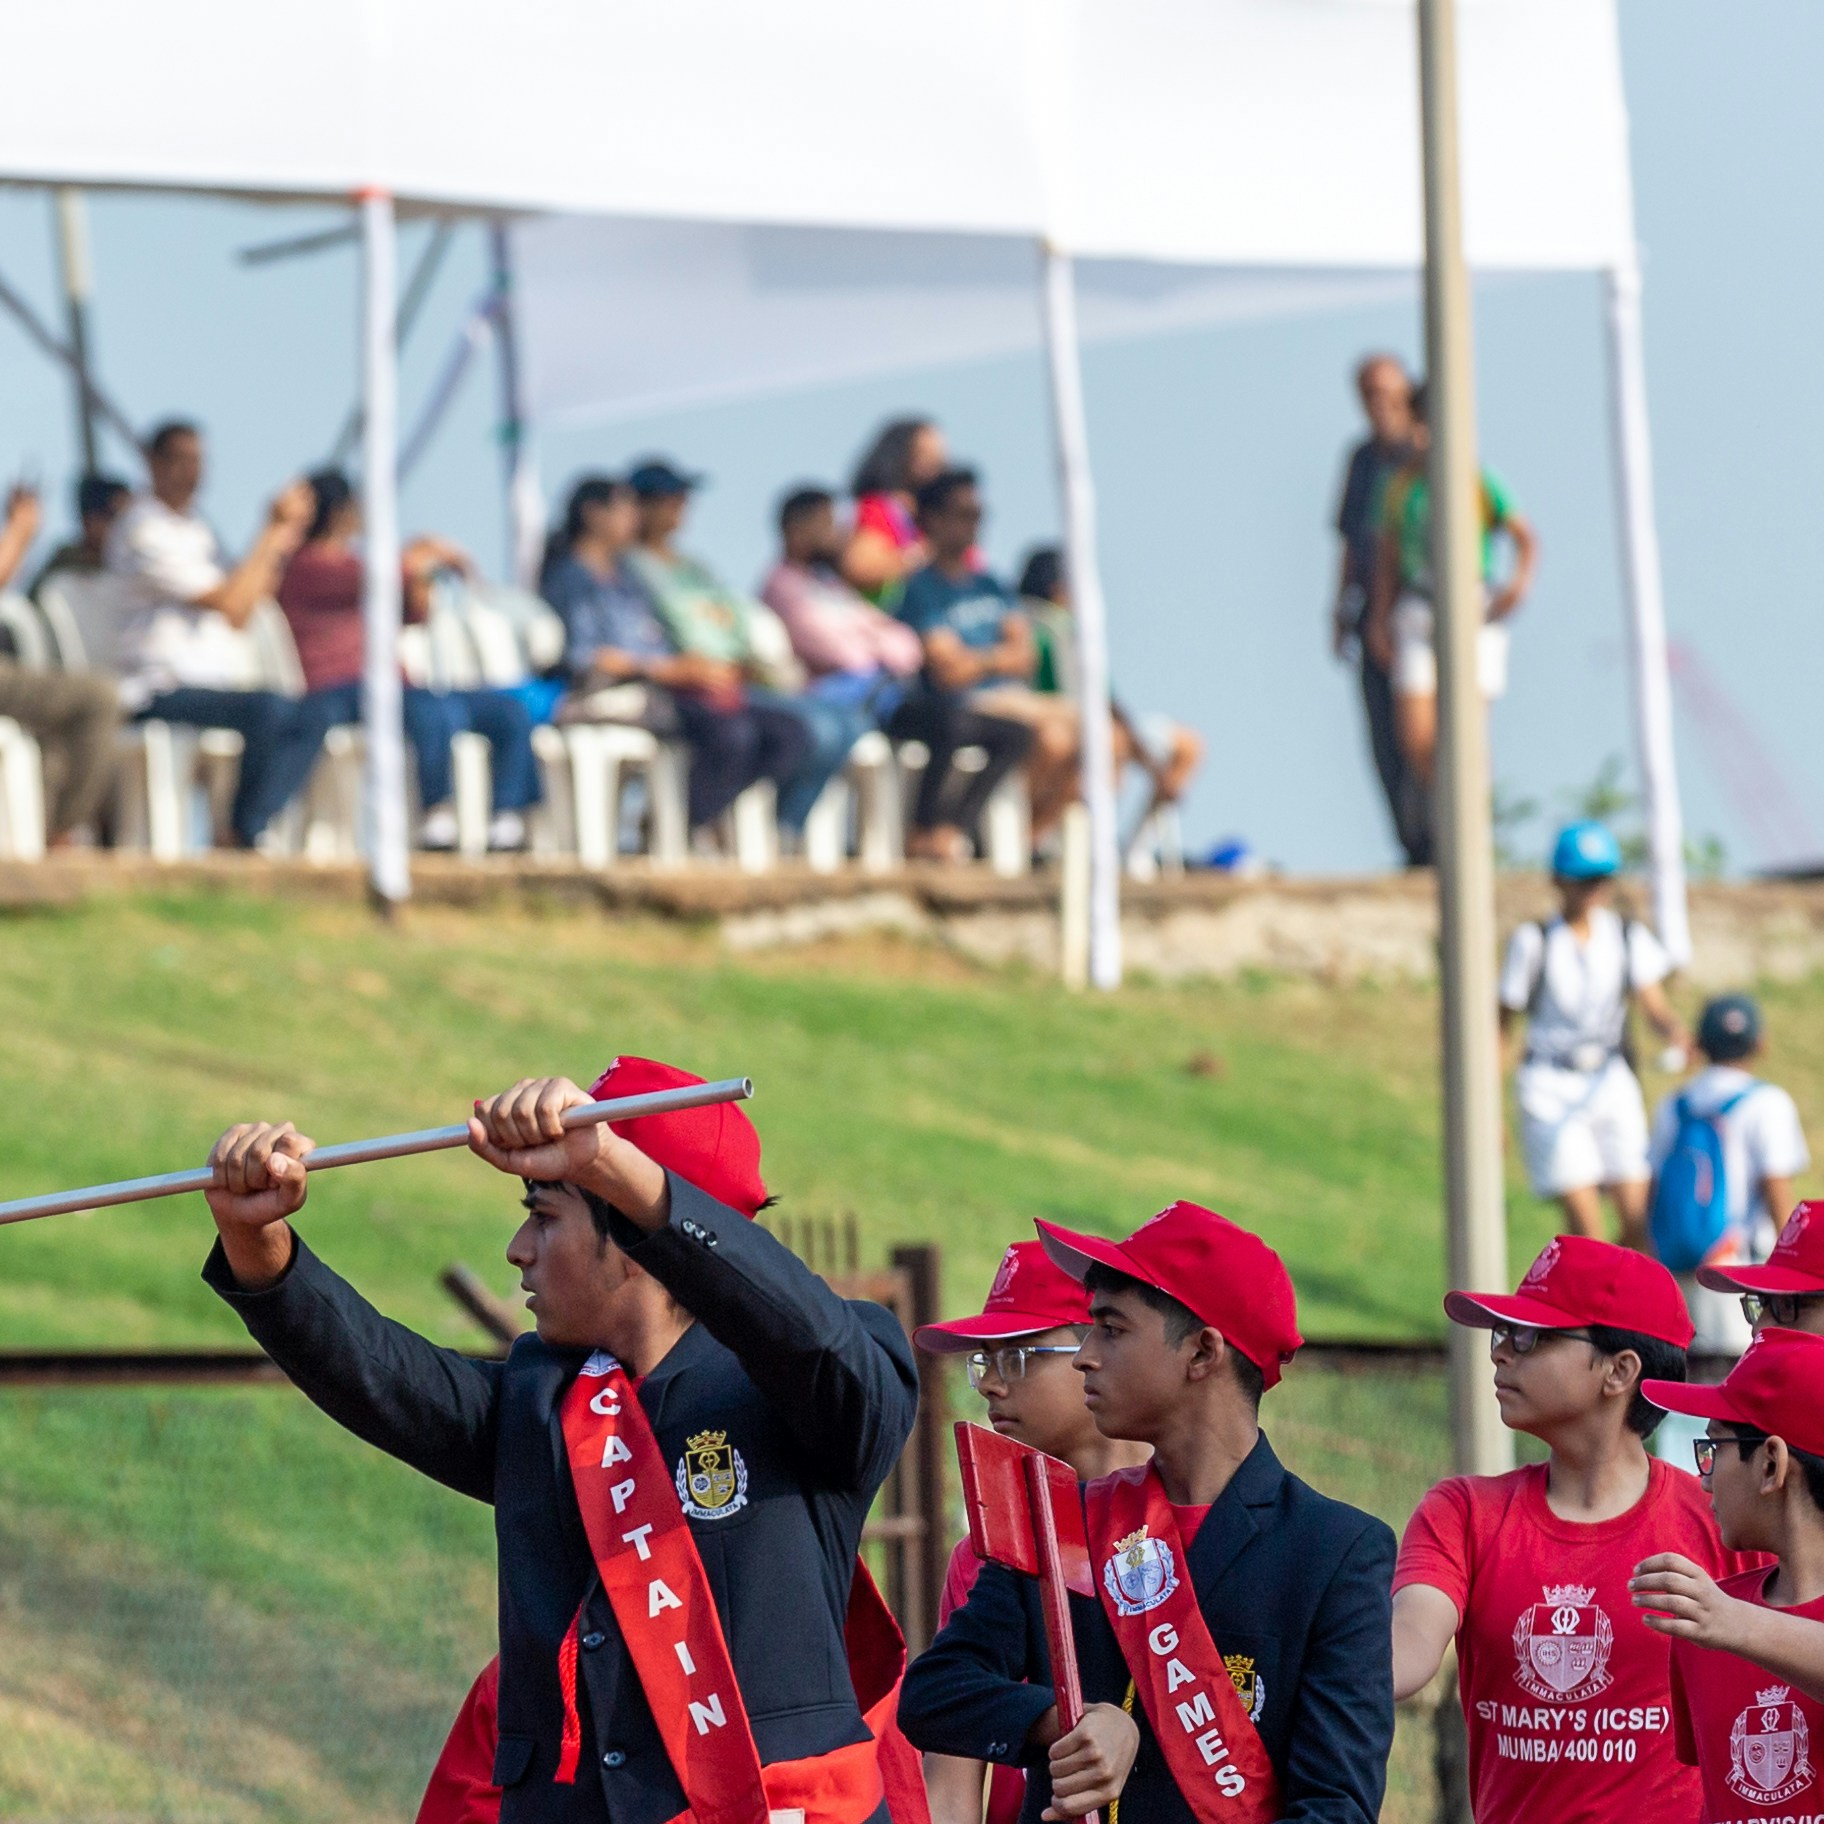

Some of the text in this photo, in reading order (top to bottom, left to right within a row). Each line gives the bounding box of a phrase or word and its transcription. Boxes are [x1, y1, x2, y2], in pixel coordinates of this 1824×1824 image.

[589, 1387, 727, 1736] CAPTAIN
[1525, 1680, 1600, 1701] IMMACULATA
[1149, 1622, 1246, 1798] GAMES
[1476, 1700, 1670, 1735] ST MARY'S (ICSE)
[1564, 1738, 1598, 1763] 400
[1602, 1737, 1637, 1763] 010
[1738, 1779, 1804, 1802] IMMACULATA
